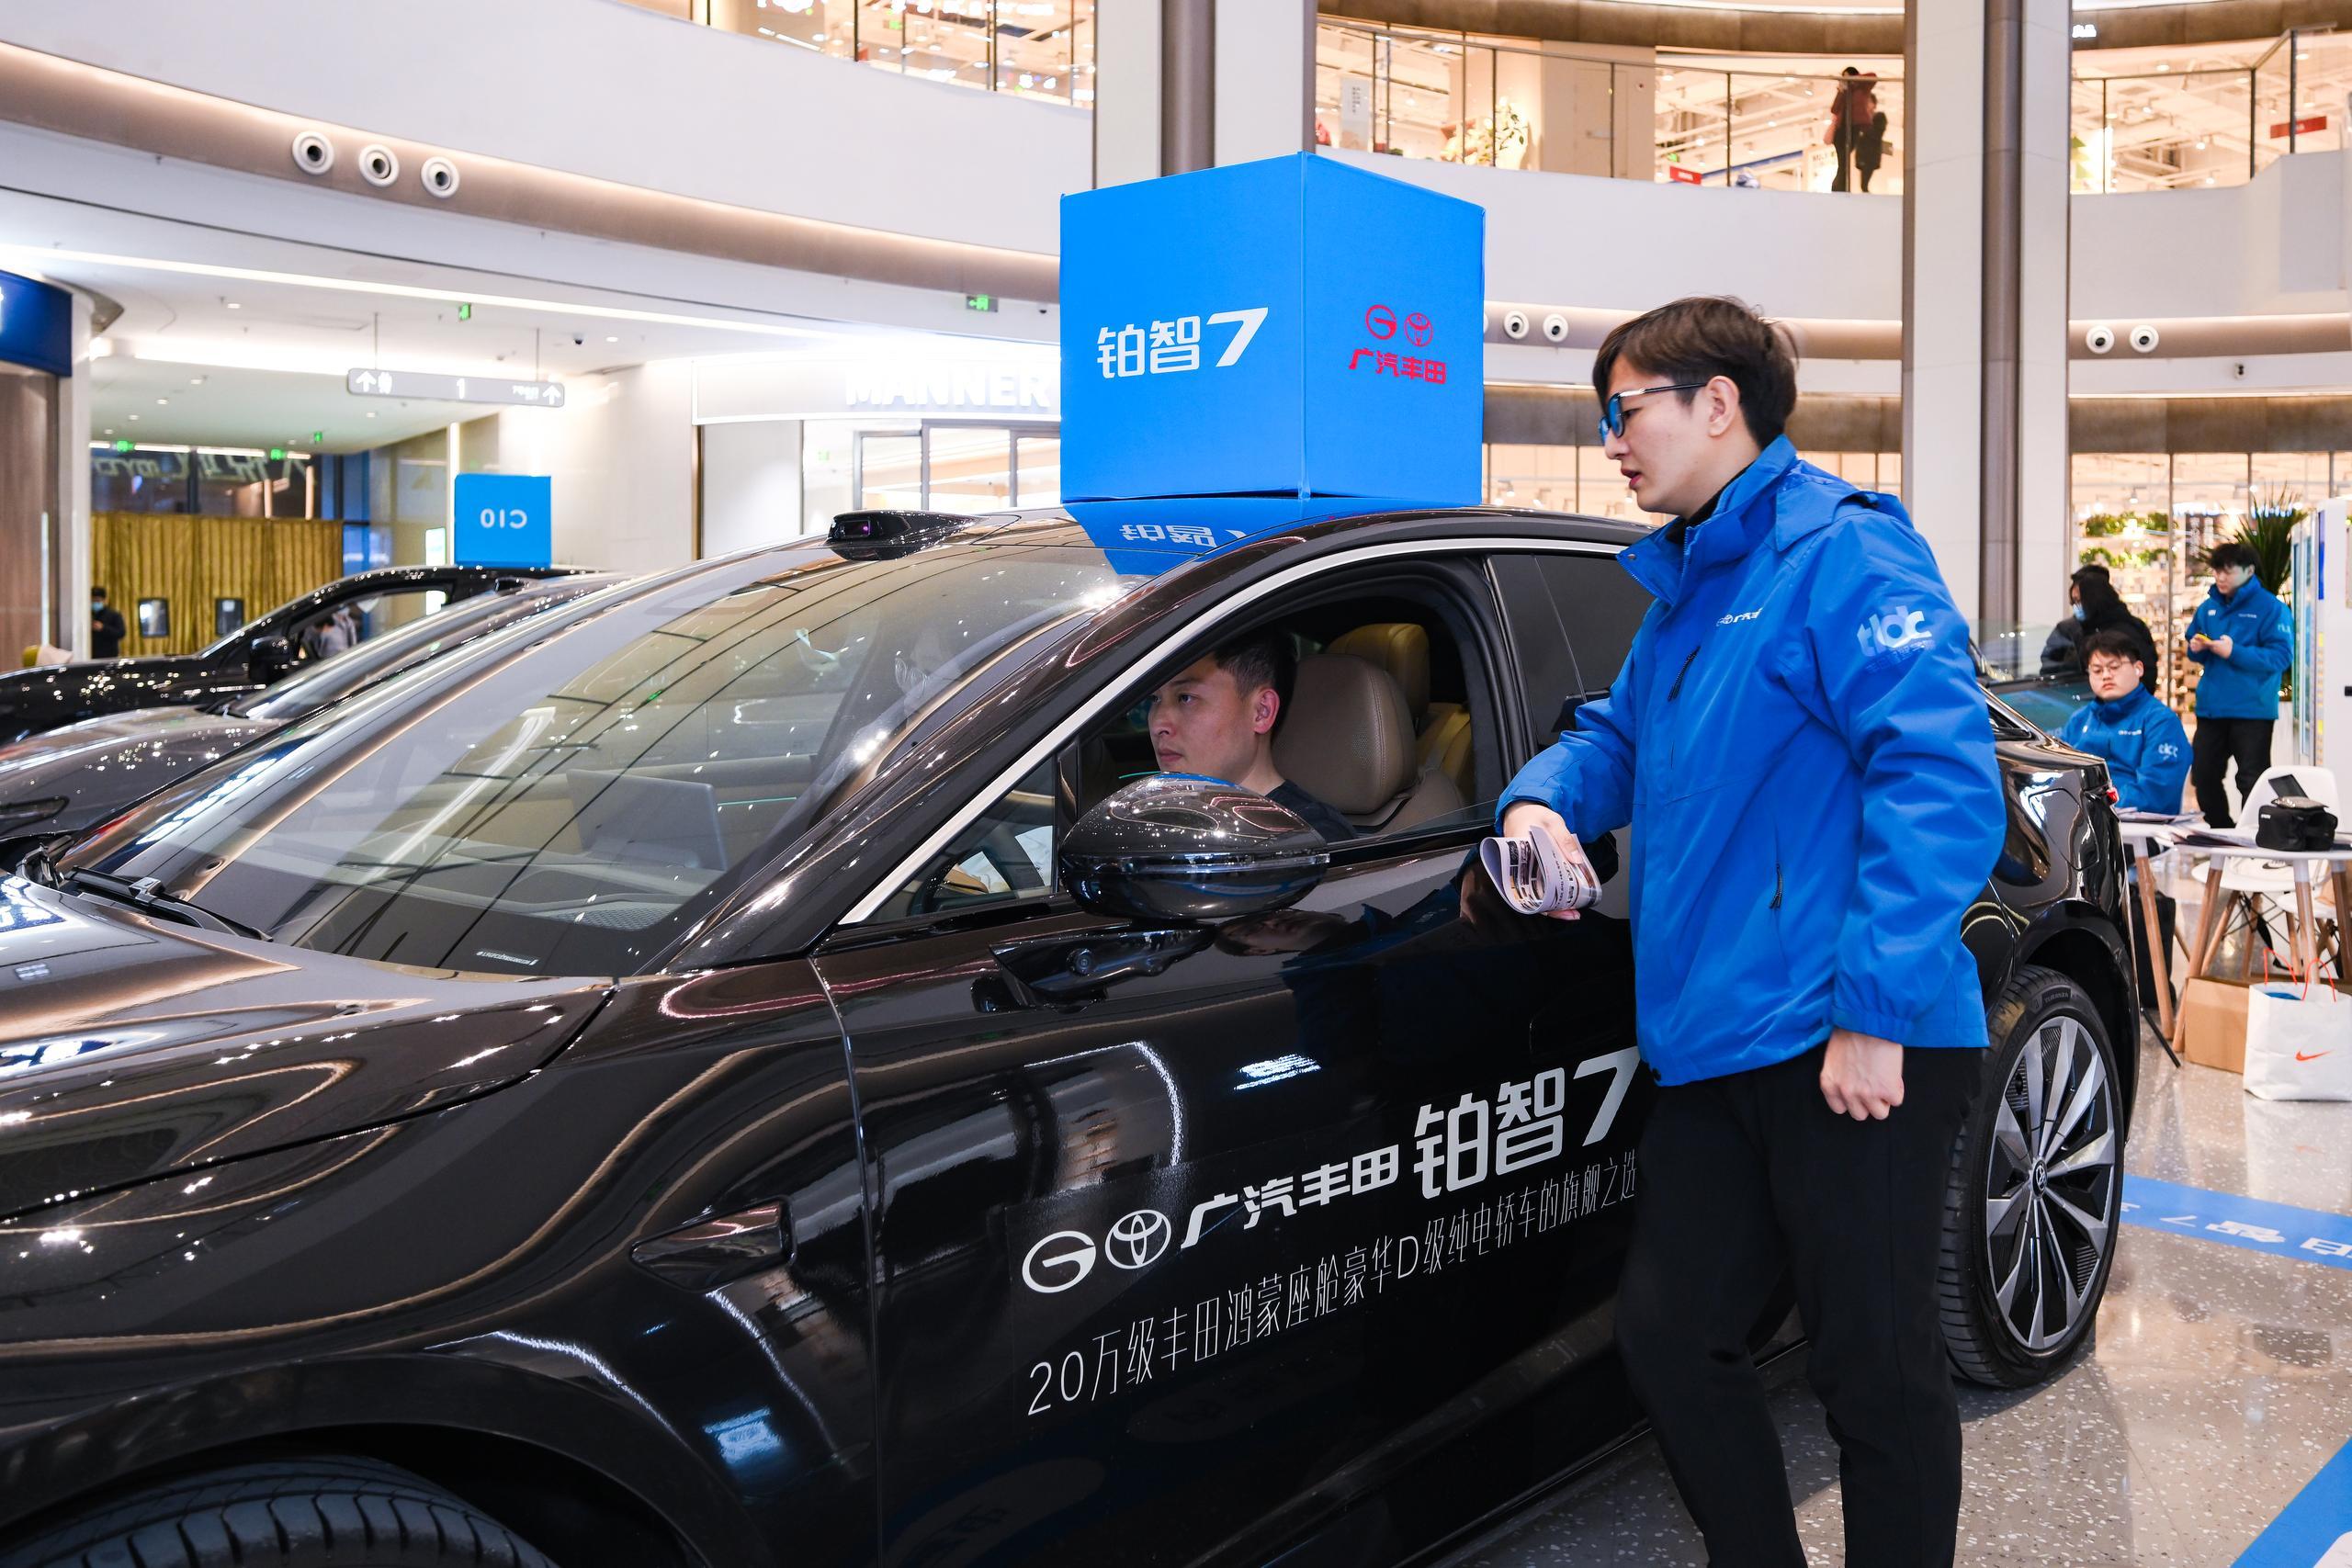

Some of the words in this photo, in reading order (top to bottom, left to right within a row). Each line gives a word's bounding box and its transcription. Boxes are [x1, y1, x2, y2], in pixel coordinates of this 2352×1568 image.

[1096, 306, 1269, 379] 铂智7
[1349, 347, 1446, 384] 广汽丰田
[844, 366, 1052, 407] MANNER
[1181, 1144, 1399, 1249] 广汽丰田
[1413, 1045, 1641, 1200] 铂智7
